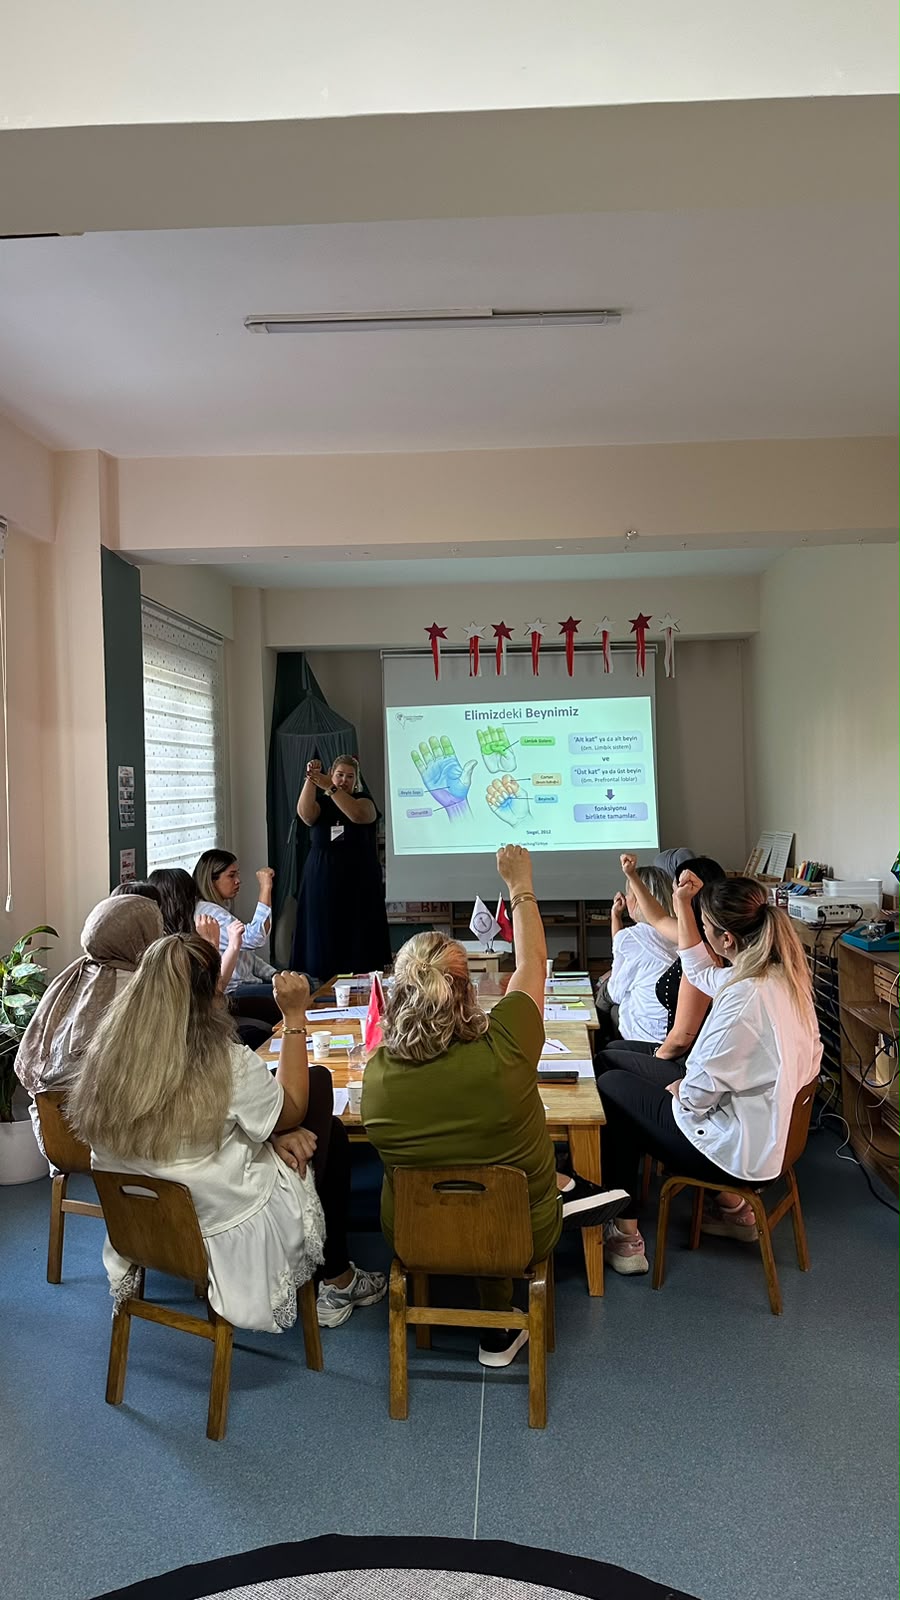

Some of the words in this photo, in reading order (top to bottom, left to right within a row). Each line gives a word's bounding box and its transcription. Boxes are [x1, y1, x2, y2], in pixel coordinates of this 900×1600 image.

[464, 708, 522, 720] Elimizdeki
[525, 706, 579, 720] Beynimiz
[594, 804, 627, 812] fonksiyonu
